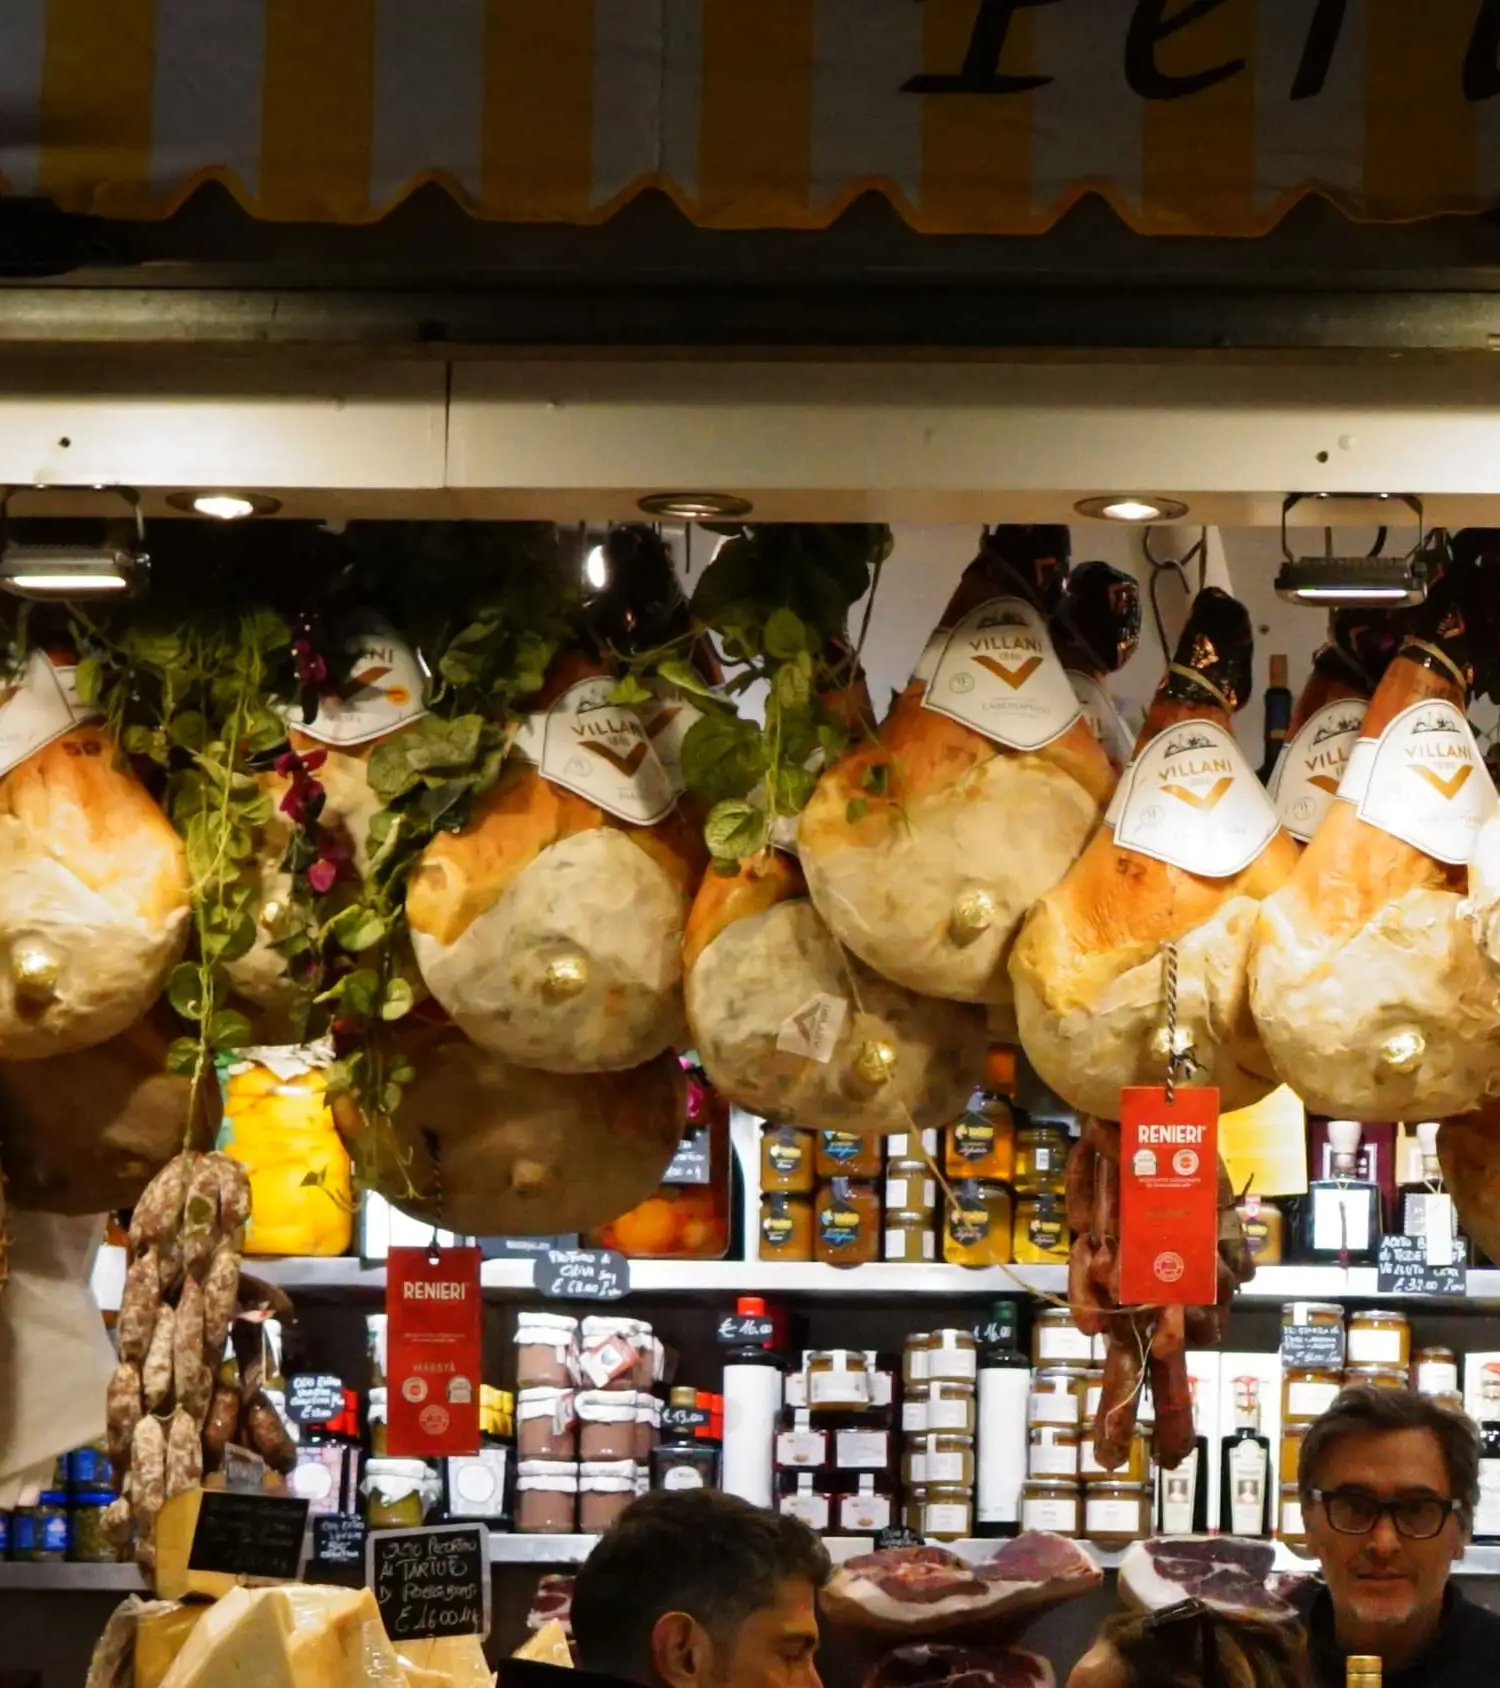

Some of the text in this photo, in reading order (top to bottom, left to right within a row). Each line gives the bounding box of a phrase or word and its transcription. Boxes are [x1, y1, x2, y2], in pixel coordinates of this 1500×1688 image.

[969, 638, 1043, 654] VILLANI
[570, 719, 641, 739] VILLANI
[1404, 743, 1473, 761] VILLANI
[1158, 758, 1235, 782] VILLANI
[1137, 1123, 1203, 1144] RENIERI
[402, 1280, 467, 1301] RENIERI
[717, 1317, 739, 1338] €
[394, 1605, 418, 1633] €
